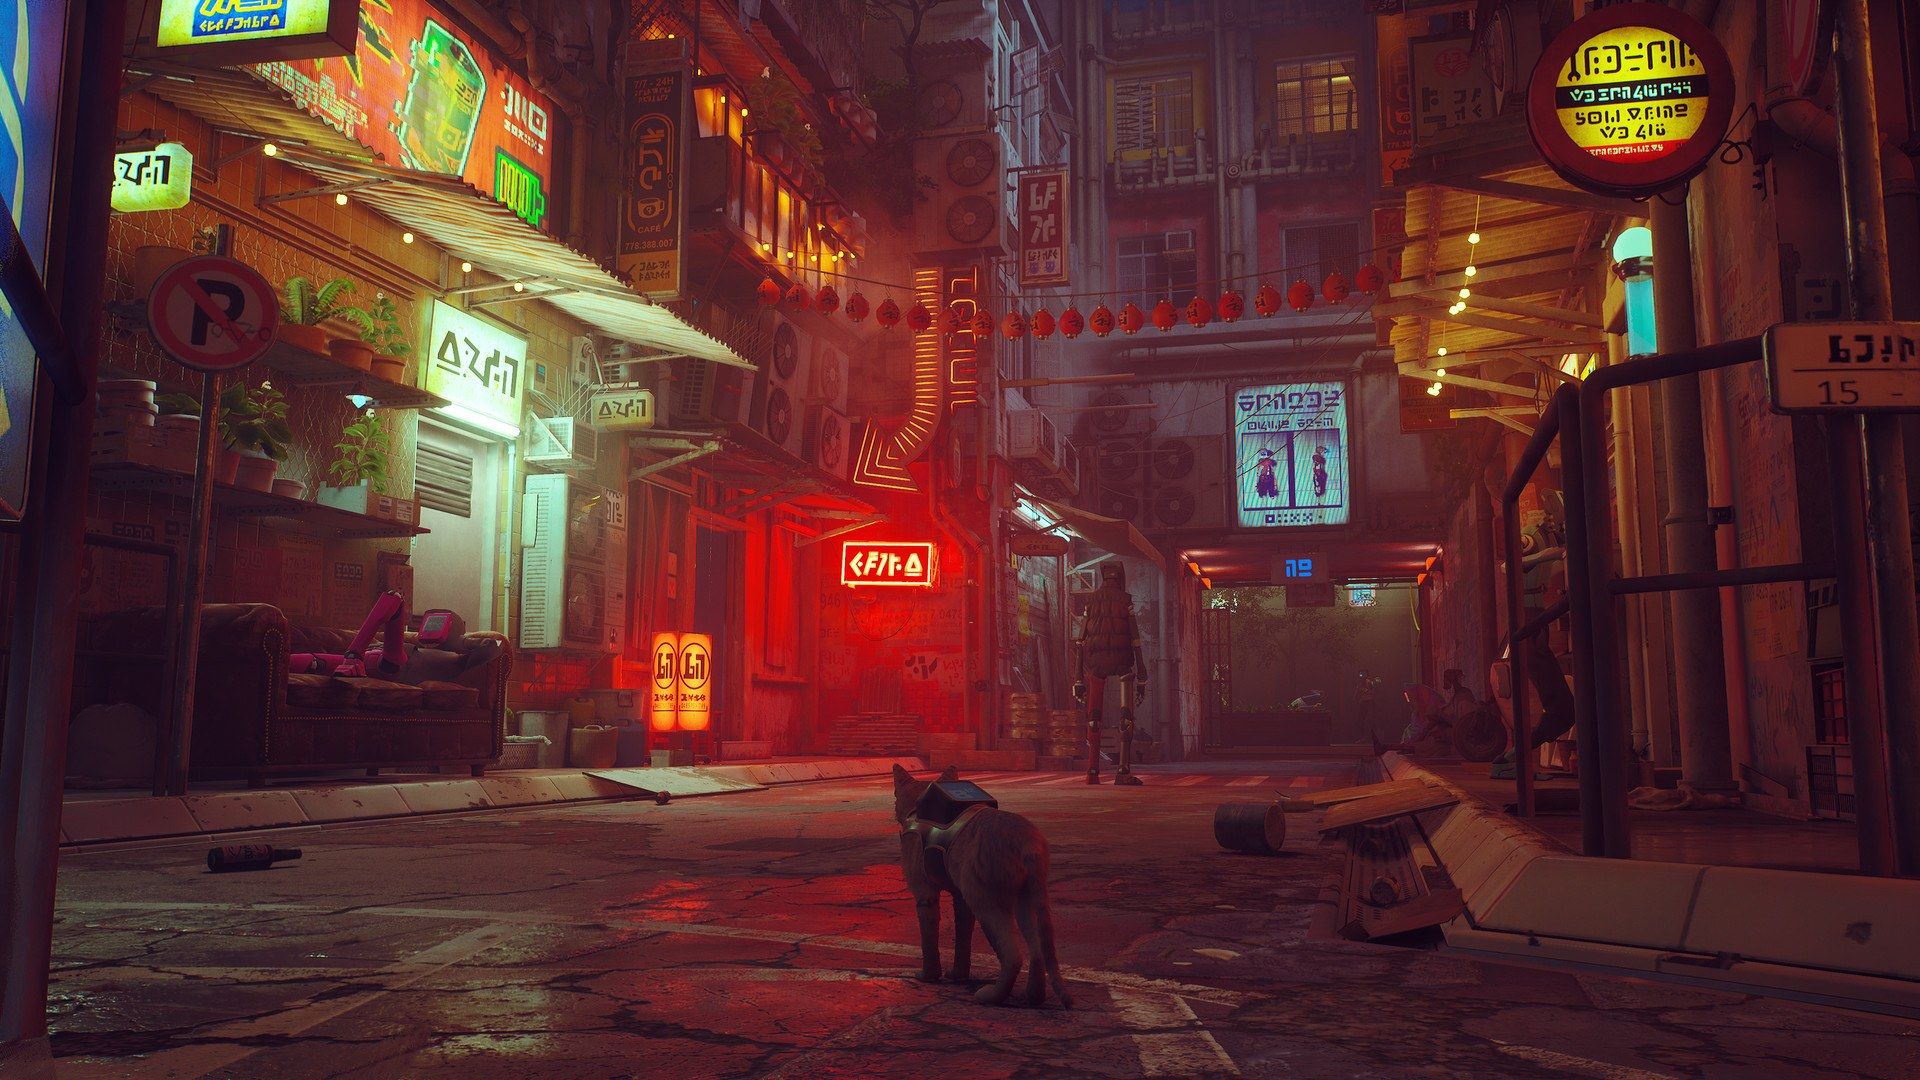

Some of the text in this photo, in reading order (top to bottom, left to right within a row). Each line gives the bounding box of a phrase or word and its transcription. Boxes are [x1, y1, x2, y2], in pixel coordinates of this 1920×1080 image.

[656, 76, 674, 87] 24H
[638, 224, 661, 234] CAFÉ
[190, 279, 246, 346] P
[1817, 379, 1860, 406] 15
